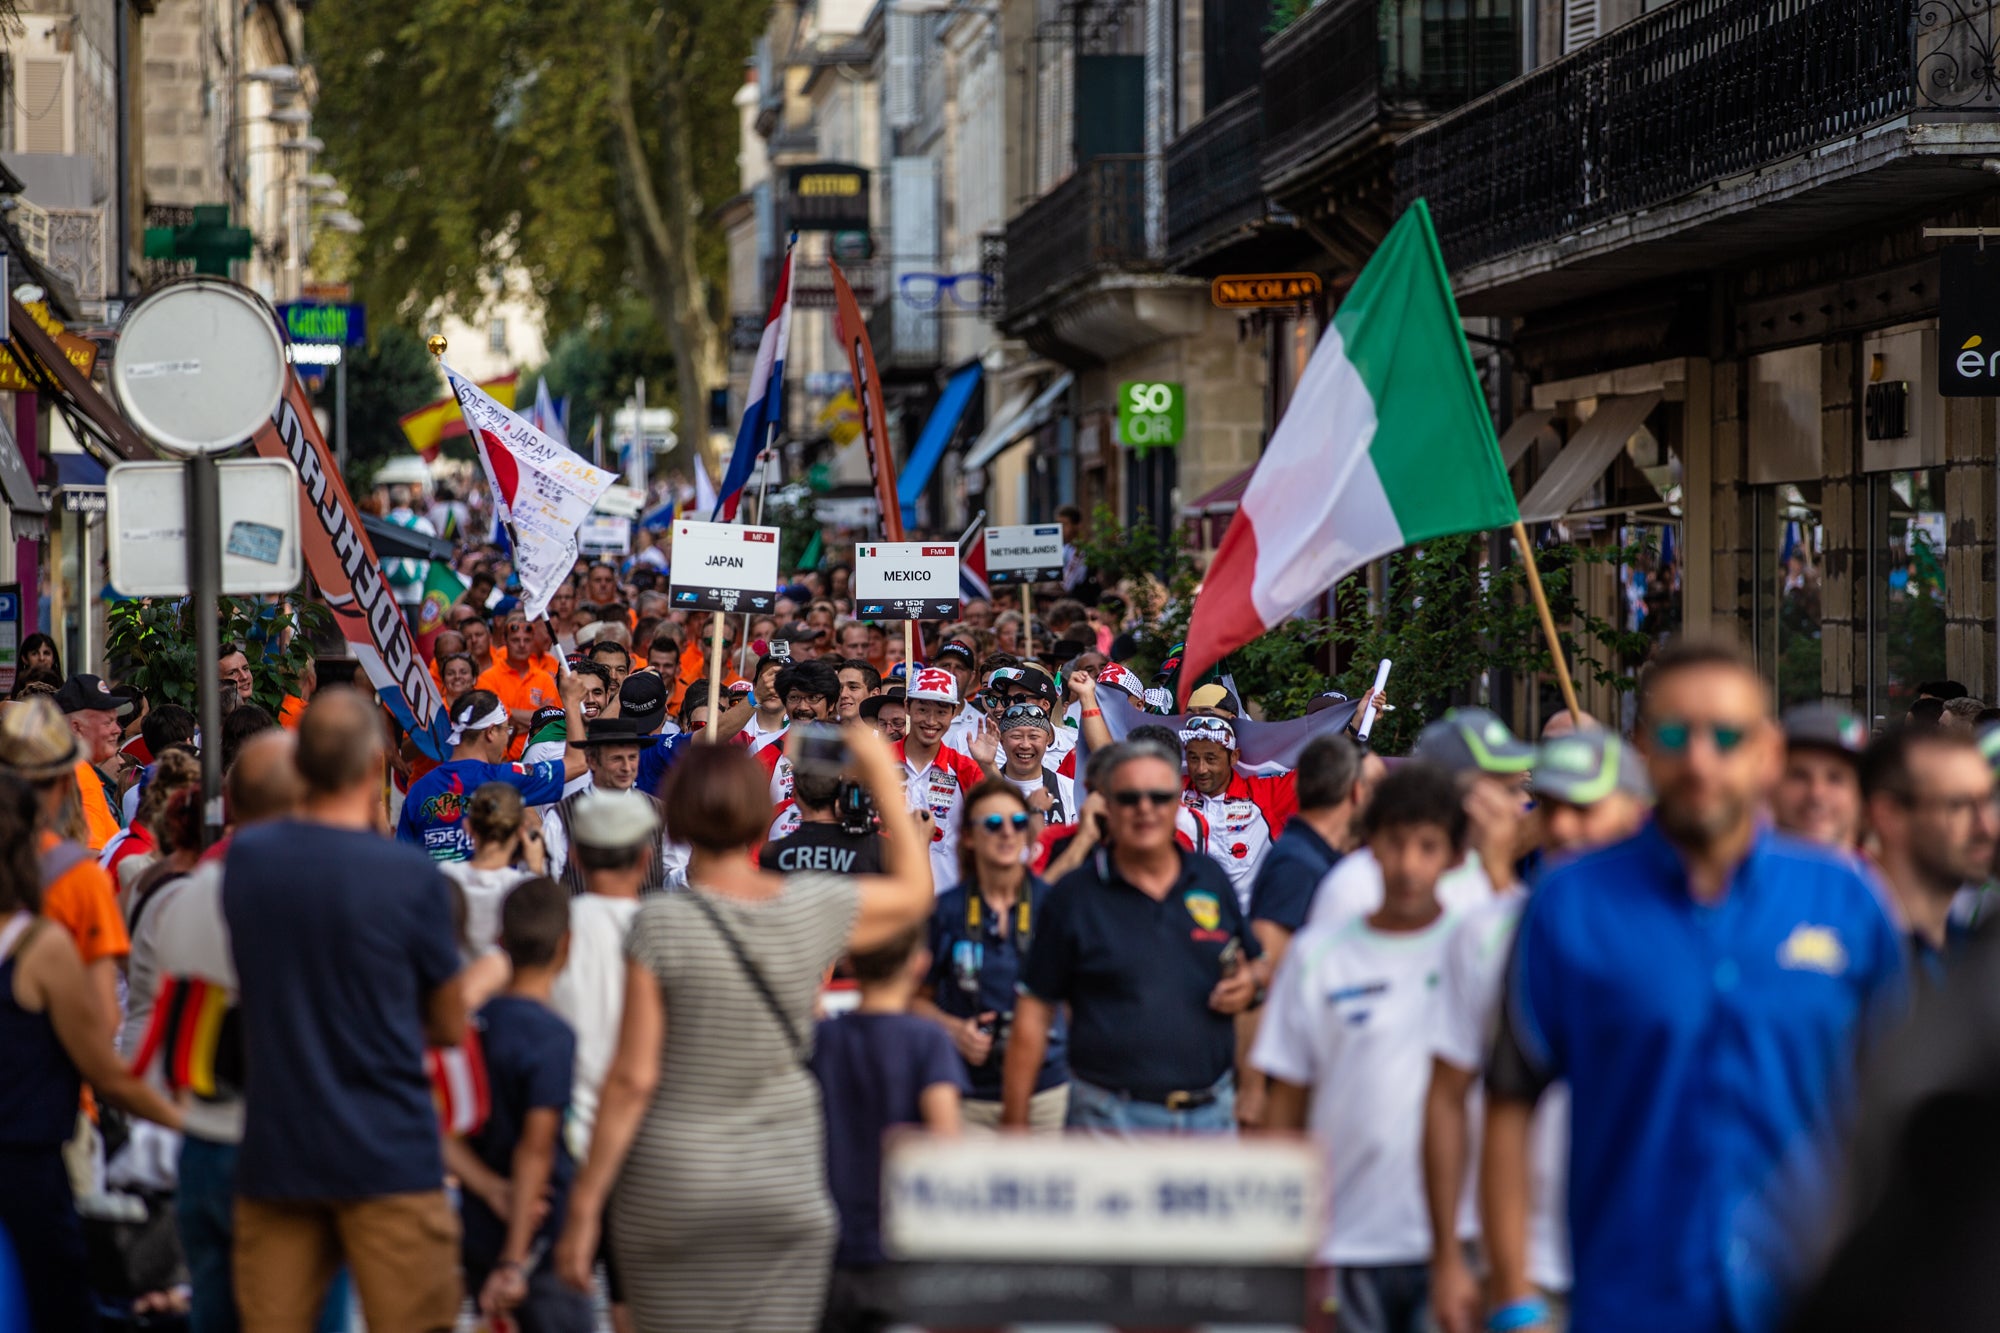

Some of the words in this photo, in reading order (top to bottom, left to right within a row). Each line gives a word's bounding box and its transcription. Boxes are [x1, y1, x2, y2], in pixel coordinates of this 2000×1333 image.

[1129, 383, 1172, 413] SO
[1128, 414, 1172, 444] OR
[509, 427, 558, 460] JAPAN
[990, 545, 1057, 556] NETHERLANDS
[705, 555, 743, 568] JAPAN
[884, 570, 931, 581] MEXICO
[943, 644, 968, 656] MEXICO
[778, 846, 857, 873] CREW
